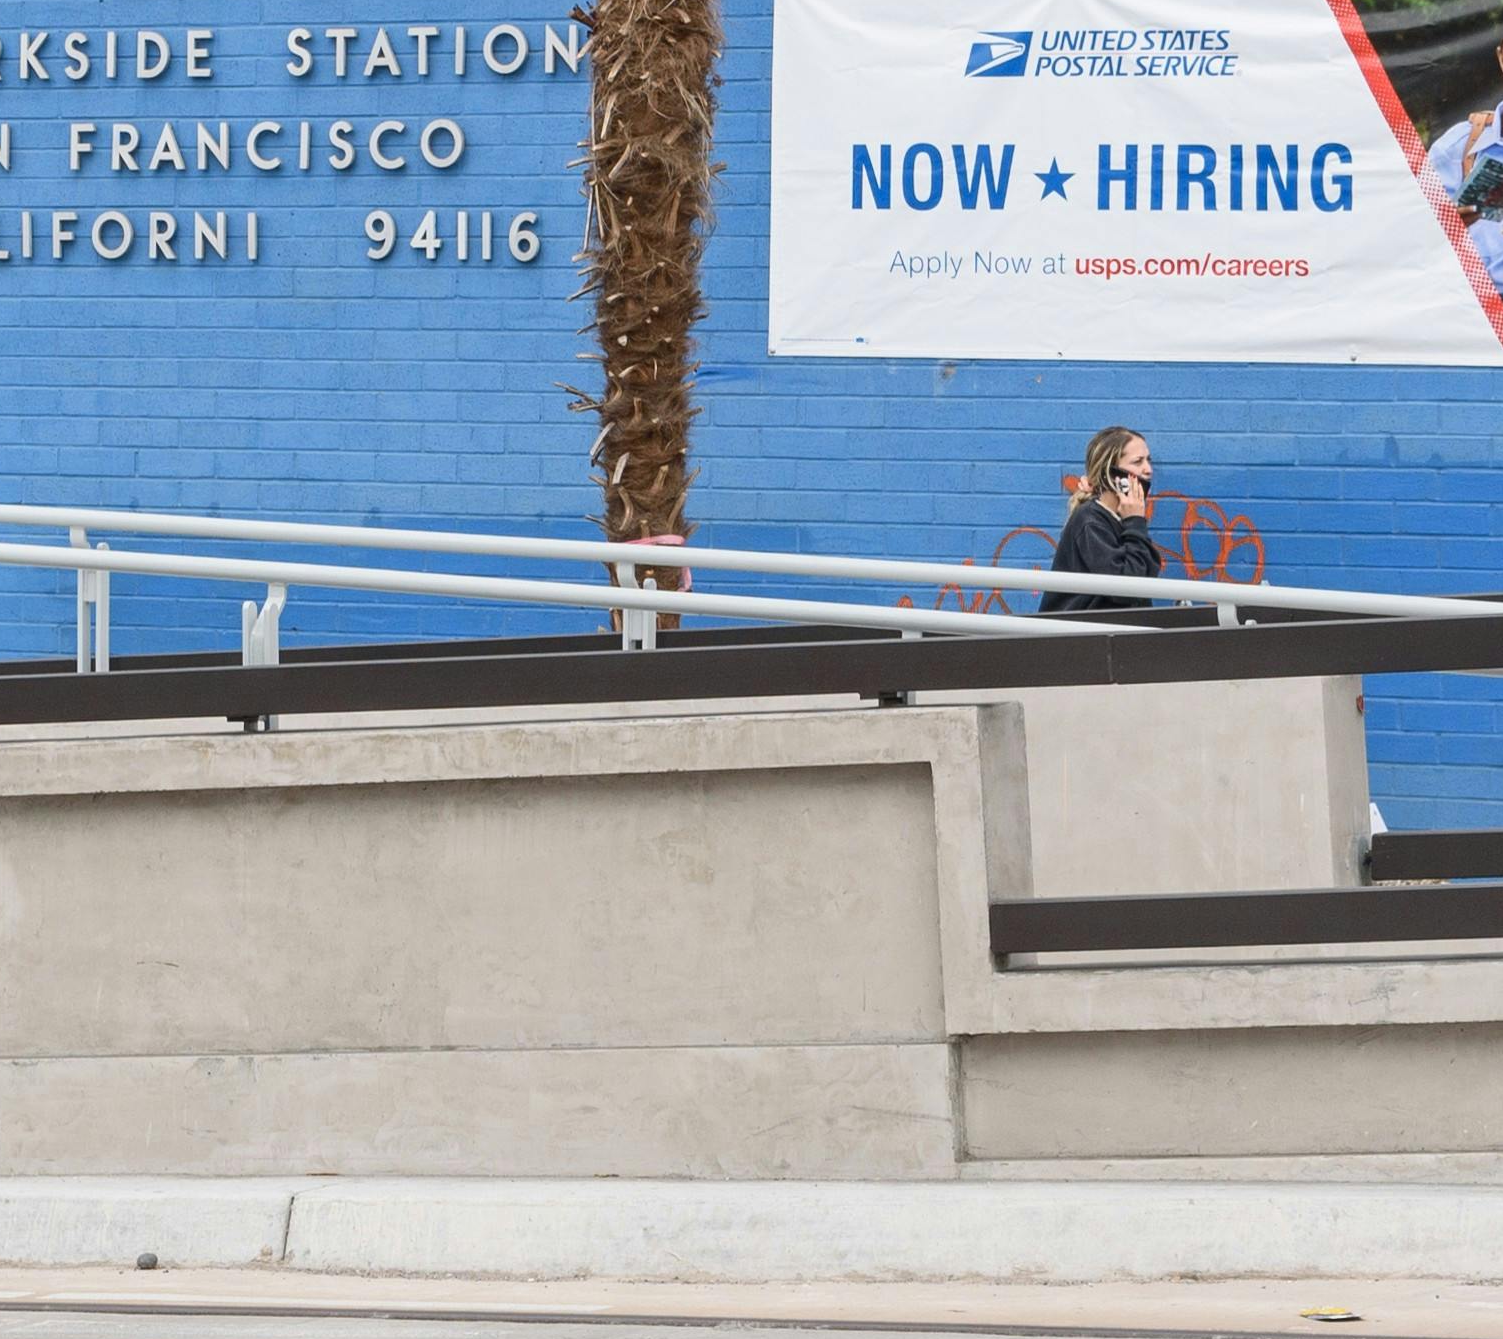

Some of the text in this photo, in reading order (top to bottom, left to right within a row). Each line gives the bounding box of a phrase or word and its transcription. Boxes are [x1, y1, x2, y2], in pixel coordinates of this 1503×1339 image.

[287, 23, 583, 77] STATION
[1035, 55, 1239, 77] POSTAL SERVICE
[1041, 30, 1231, 51] UNITED STATES
[69, 117, 467, 171] FRANCISCO
[851, 142, 1355, 212] NOW HIRING
[363, 209, 542, 262] 94116
[889, 249, 1310, 281] Apply Now at usps.com/careers
